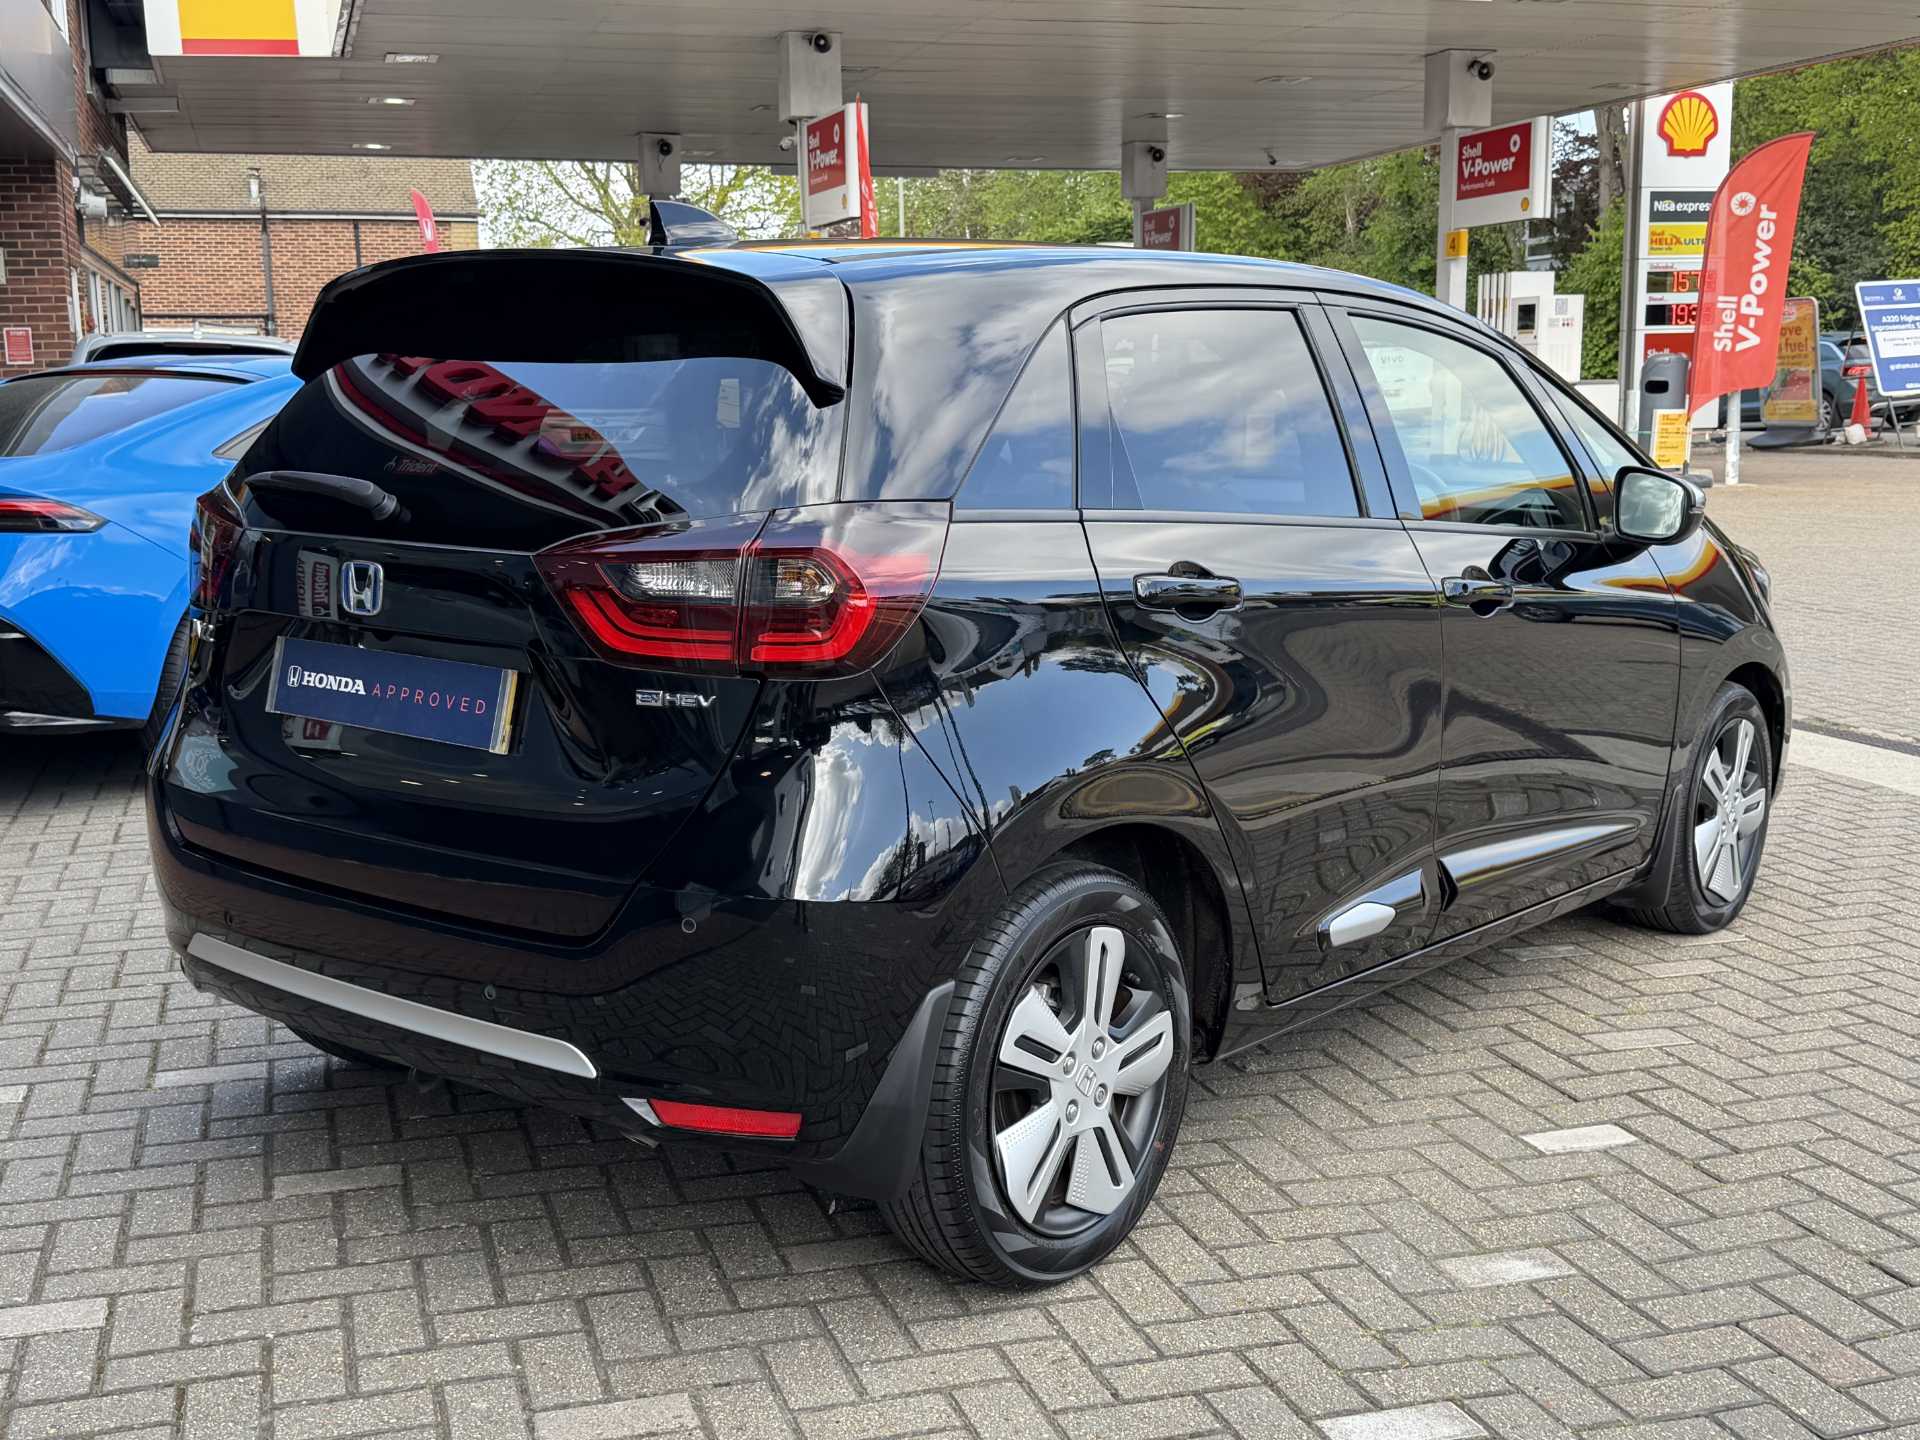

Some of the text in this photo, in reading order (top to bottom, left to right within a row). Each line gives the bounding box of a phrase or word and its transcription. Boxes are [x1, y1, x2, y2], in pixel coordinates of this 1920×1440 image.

[808, 131, 820, 150] Shell
[808, 149, 838, 172] V-Power
[1461, 142, 1482, 160] Shell
[1462, 155, 1516, 179] V-Power
[1653, 200, 1711, 213] Nisa expres
[1449, 237, 1457, 252] 4
[1650, 236, 1682, 245] HELIX
[1735, 203, 1777, 352] V-Power
[1713, 296, 1738, 352] Shell
[1785, 337, 1808, 353] fuel
[302, 671, 487, 715] HONDA APPROVED
